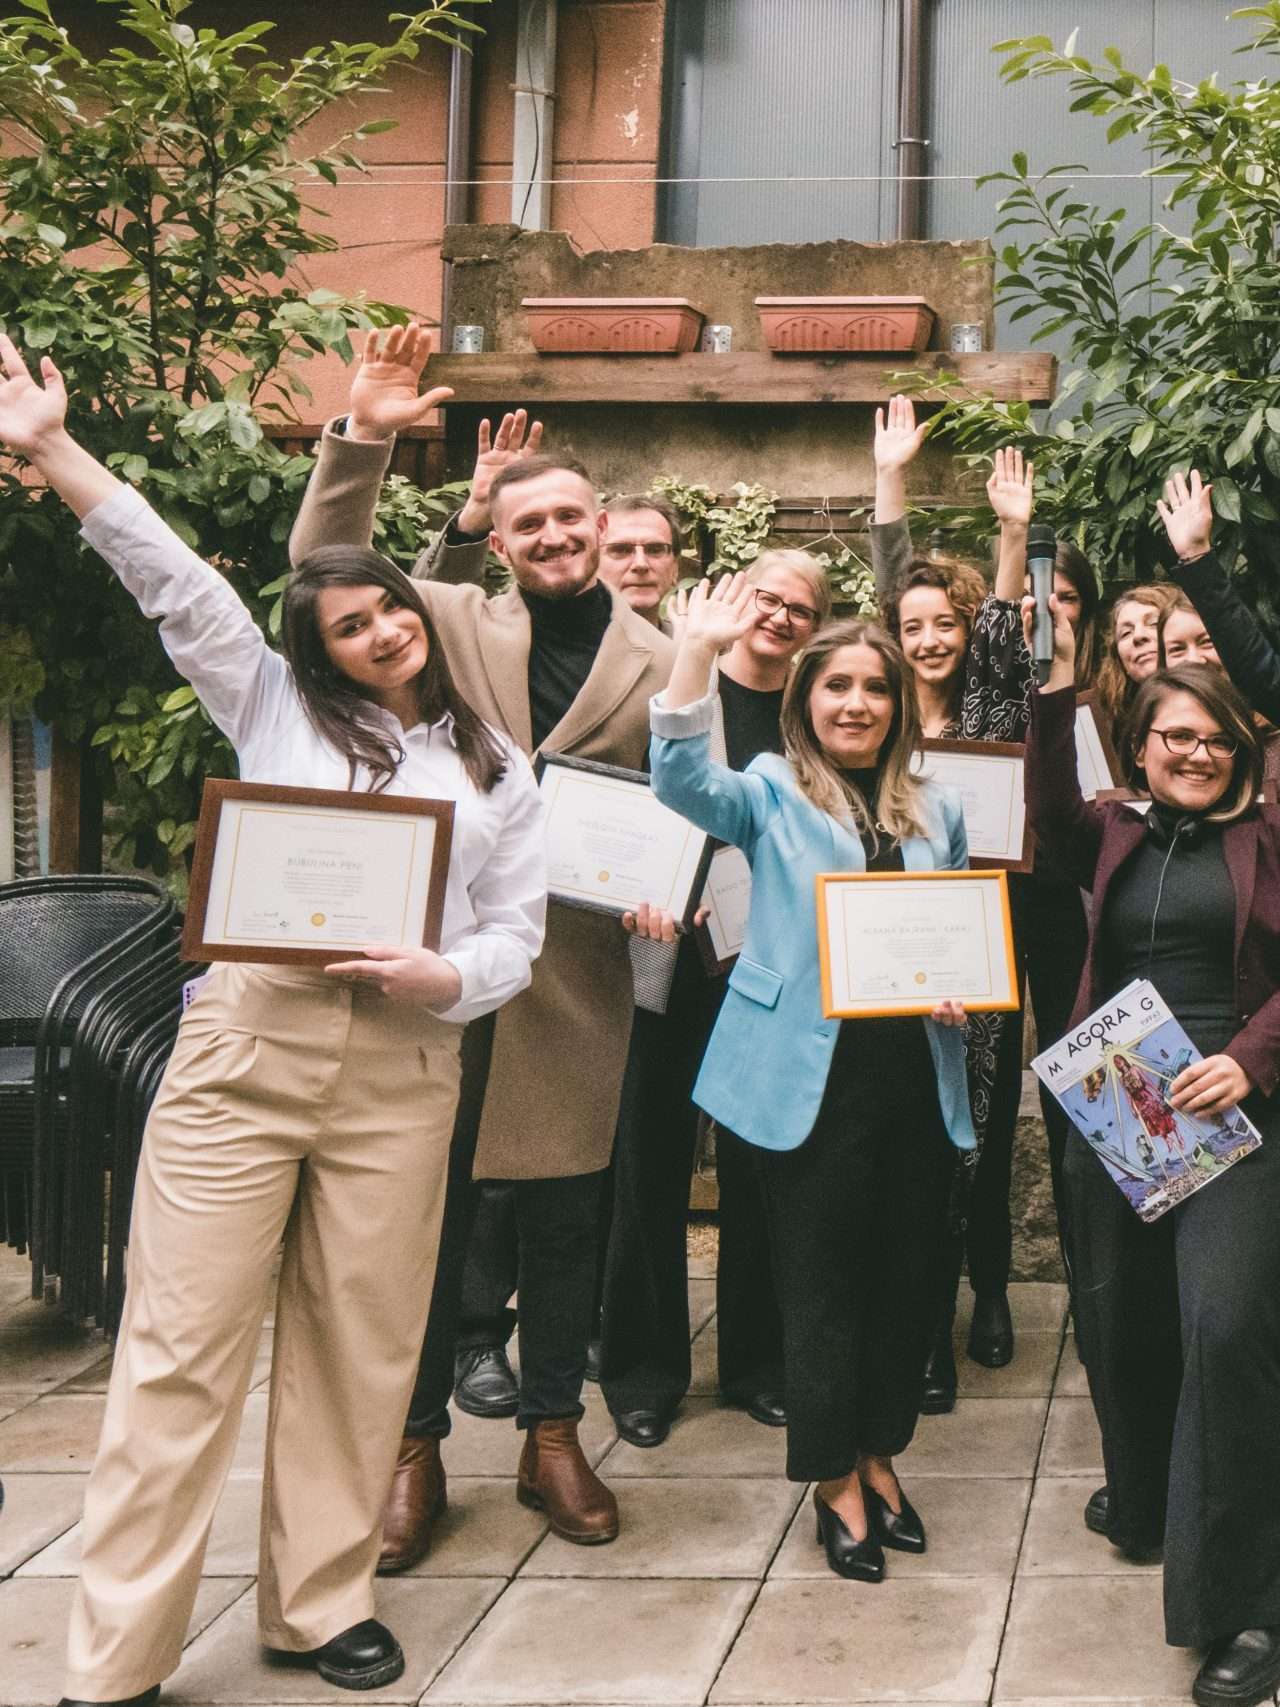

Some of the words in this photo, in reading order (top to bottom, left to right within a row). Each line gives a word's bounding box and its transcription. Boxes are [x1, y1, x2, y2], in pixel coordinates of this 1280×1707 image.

[1048, 1062, 1063, 1077] M
[1066, 1007, 1131, 1058] AGORA
[1140, 996, 1154, 1011] G
